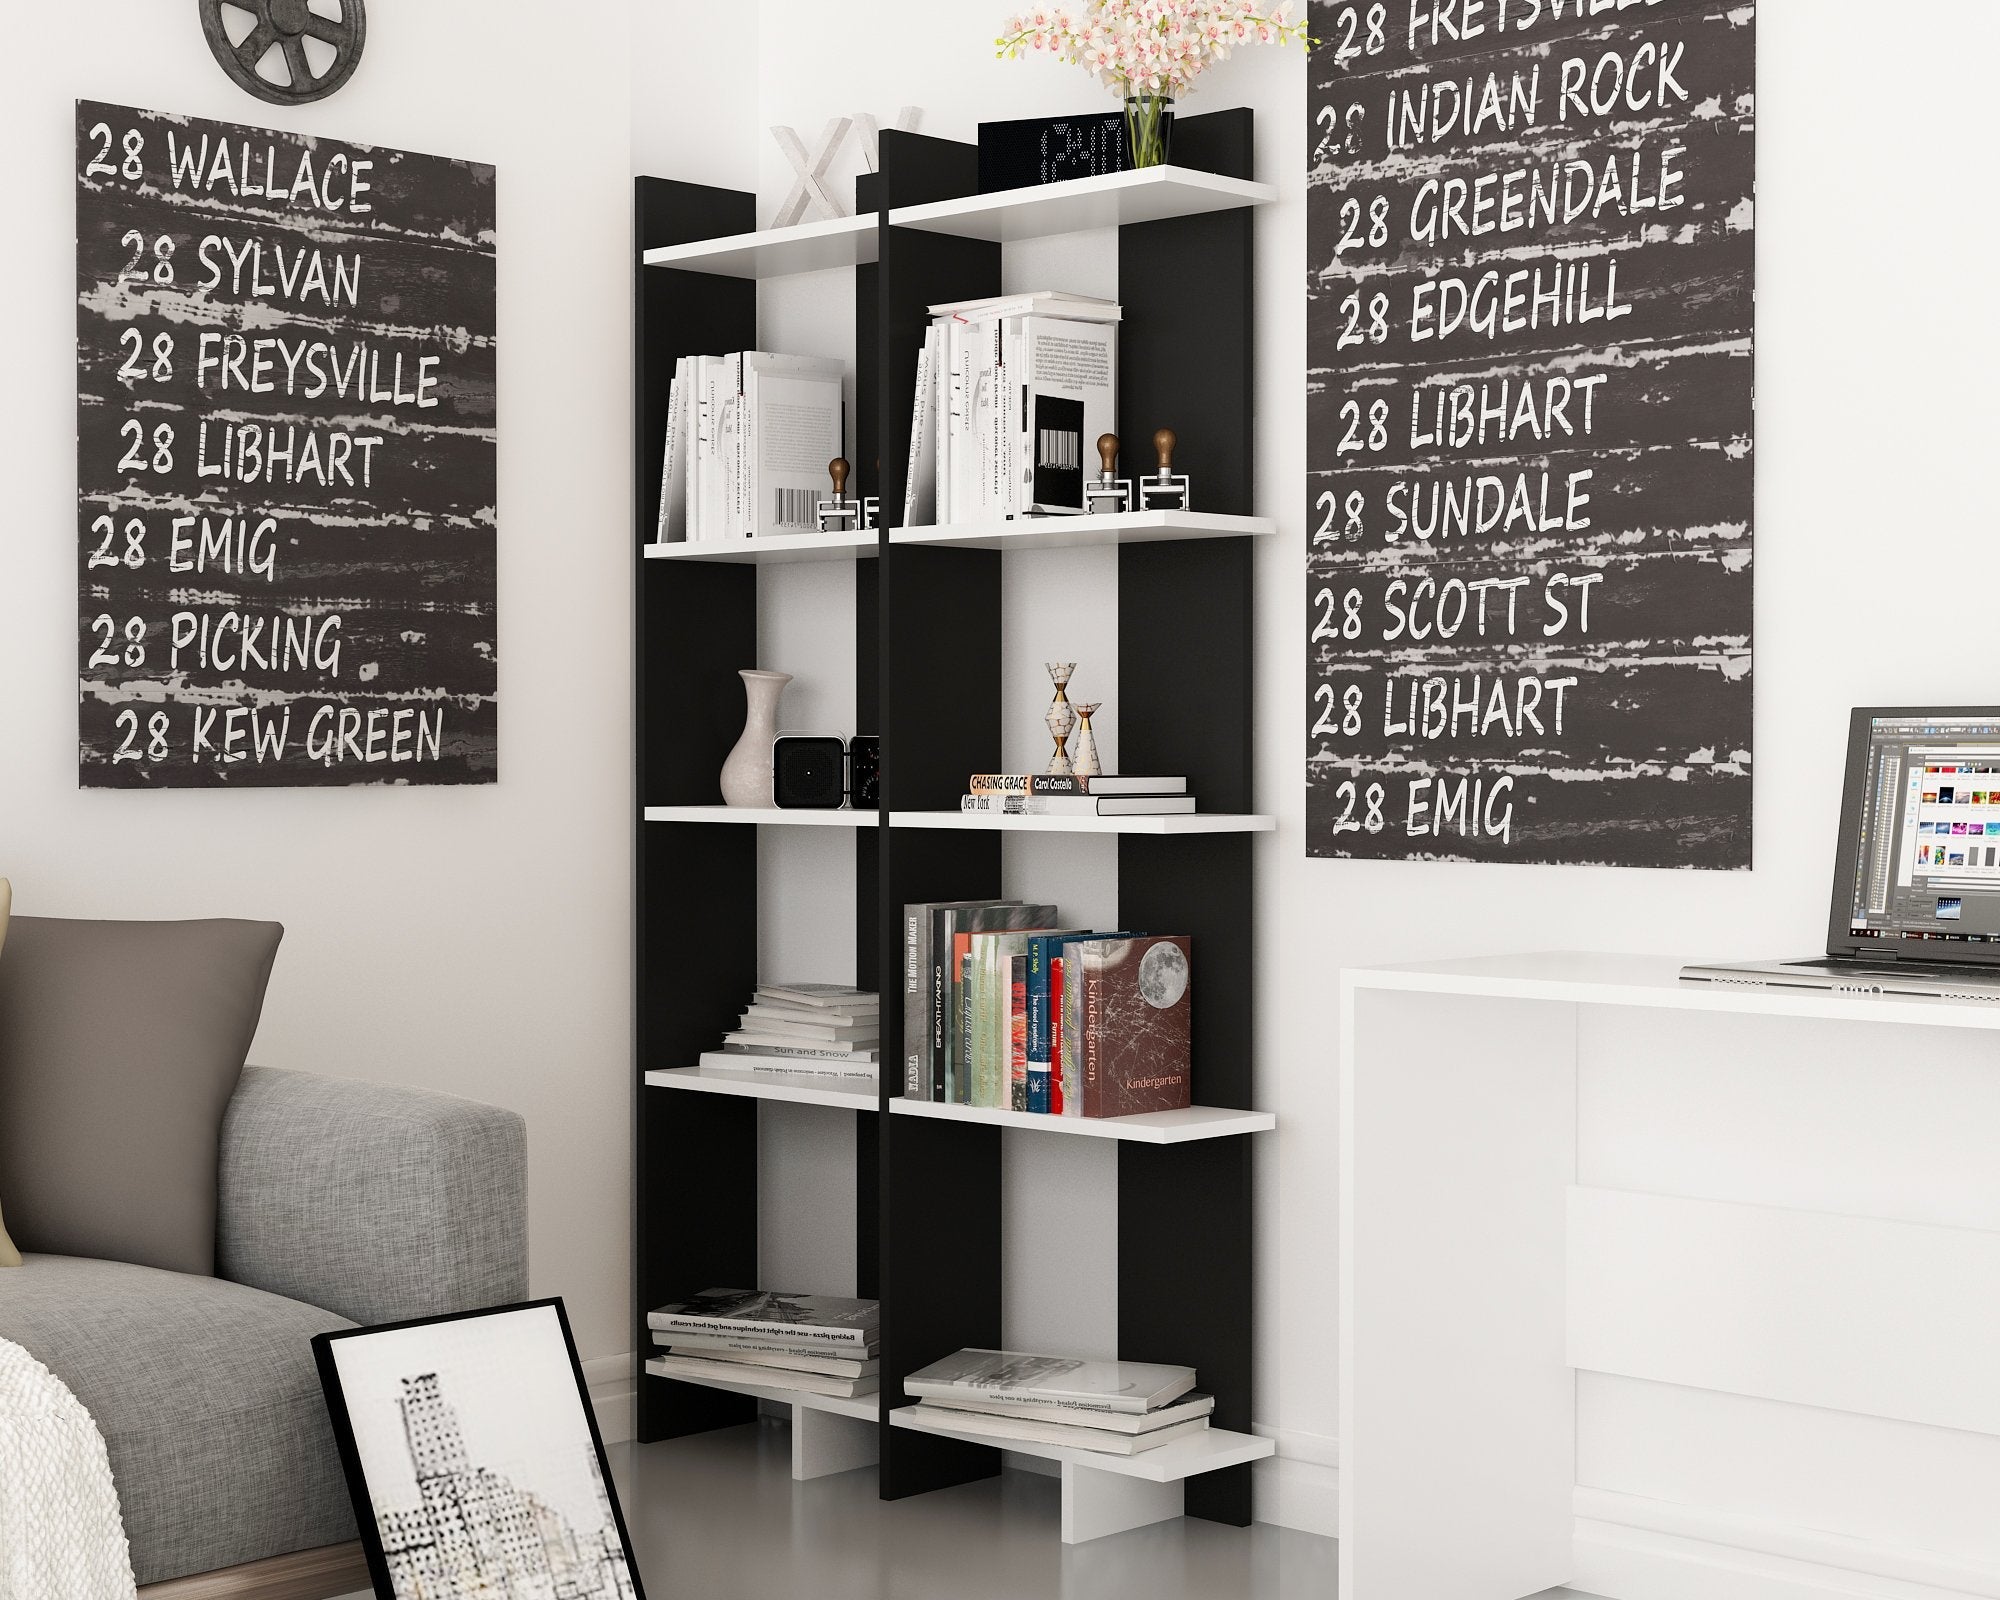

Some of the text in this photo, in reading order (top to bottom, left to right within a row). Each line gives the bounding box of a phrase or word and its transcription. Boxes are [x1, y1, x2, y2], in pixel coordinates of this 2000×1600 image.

[1334, 3, 1386, 65] 28
[1313, 40, 1689, 162] 28 INDIAN ROCK
[86, 122, 373, 213] 28 WALLACE
[1336, 146, 1687, 255] 28 GREENDALE
[118, 230, 360, 309] 28 SYLVAN
[1336, 258, 1632, 352] 28 EDGEHILL
[117, 328, 440, 408] 28 FREYSVILLE
[915, 431, 923, 458] Sun
[921, 355, 930, 396] Snow
[1336, 373, 1608, 456] 28 LIBHART
[117, 419, 384, 488] 28 LIBHART
[1312, 468, 1593, 546] 28 SUNDALE
[88, 515, 277, 582] 28 EMIG
[1311, 572, 1604, 643] 28 SCOTT ST
[88, 611, 341, 677] 28 PICKING
[113, 704, 443, 767] 28 KEW GREEN
[1311, 675, 1577, 739] 28 LIBHART
[963, 795, 990, 810] New York
[971, 776, 1028, 790] CHASING GRACE
[1034, 777, 1049, 790] Carol
[1333, 775, 1514, 845] 28 EMIG
[908, 917, 918, 945] MAKER
[907, 979, 918, 994] THE
[773, 1046, 850, 1059] Sun and Snow
[1086, 979, 1099, 1082] Kindergarten
[1126, 1075, 1182, 1090] Kindergarten
